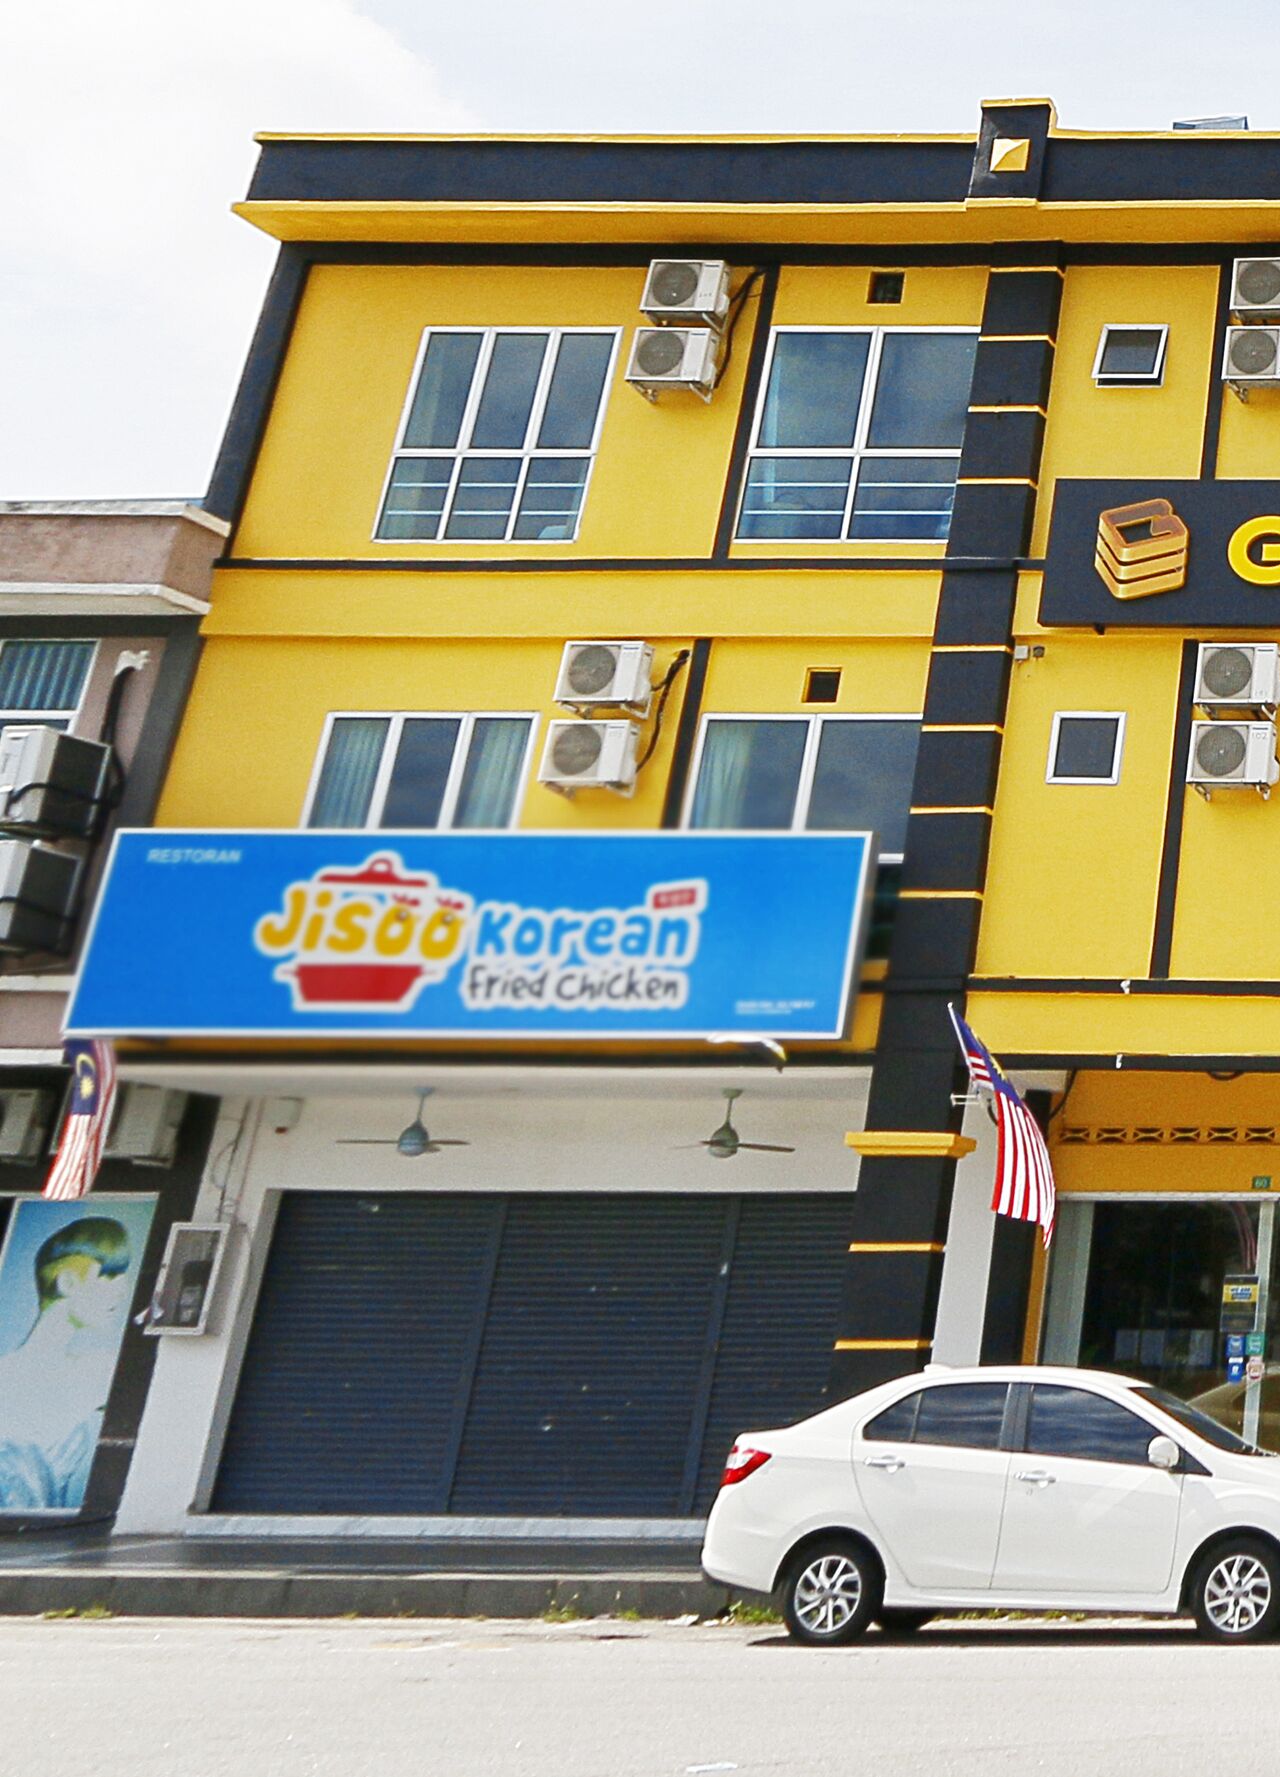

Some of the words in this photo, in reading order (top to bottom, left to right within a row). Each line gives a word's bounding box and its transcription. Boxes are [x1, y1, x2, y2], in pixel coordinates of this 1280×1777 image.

[147, 849, 242, 863] RESTORAN
[475, 909, 690, 957] Korean
[555, 965, 678, 1001] Chicken
